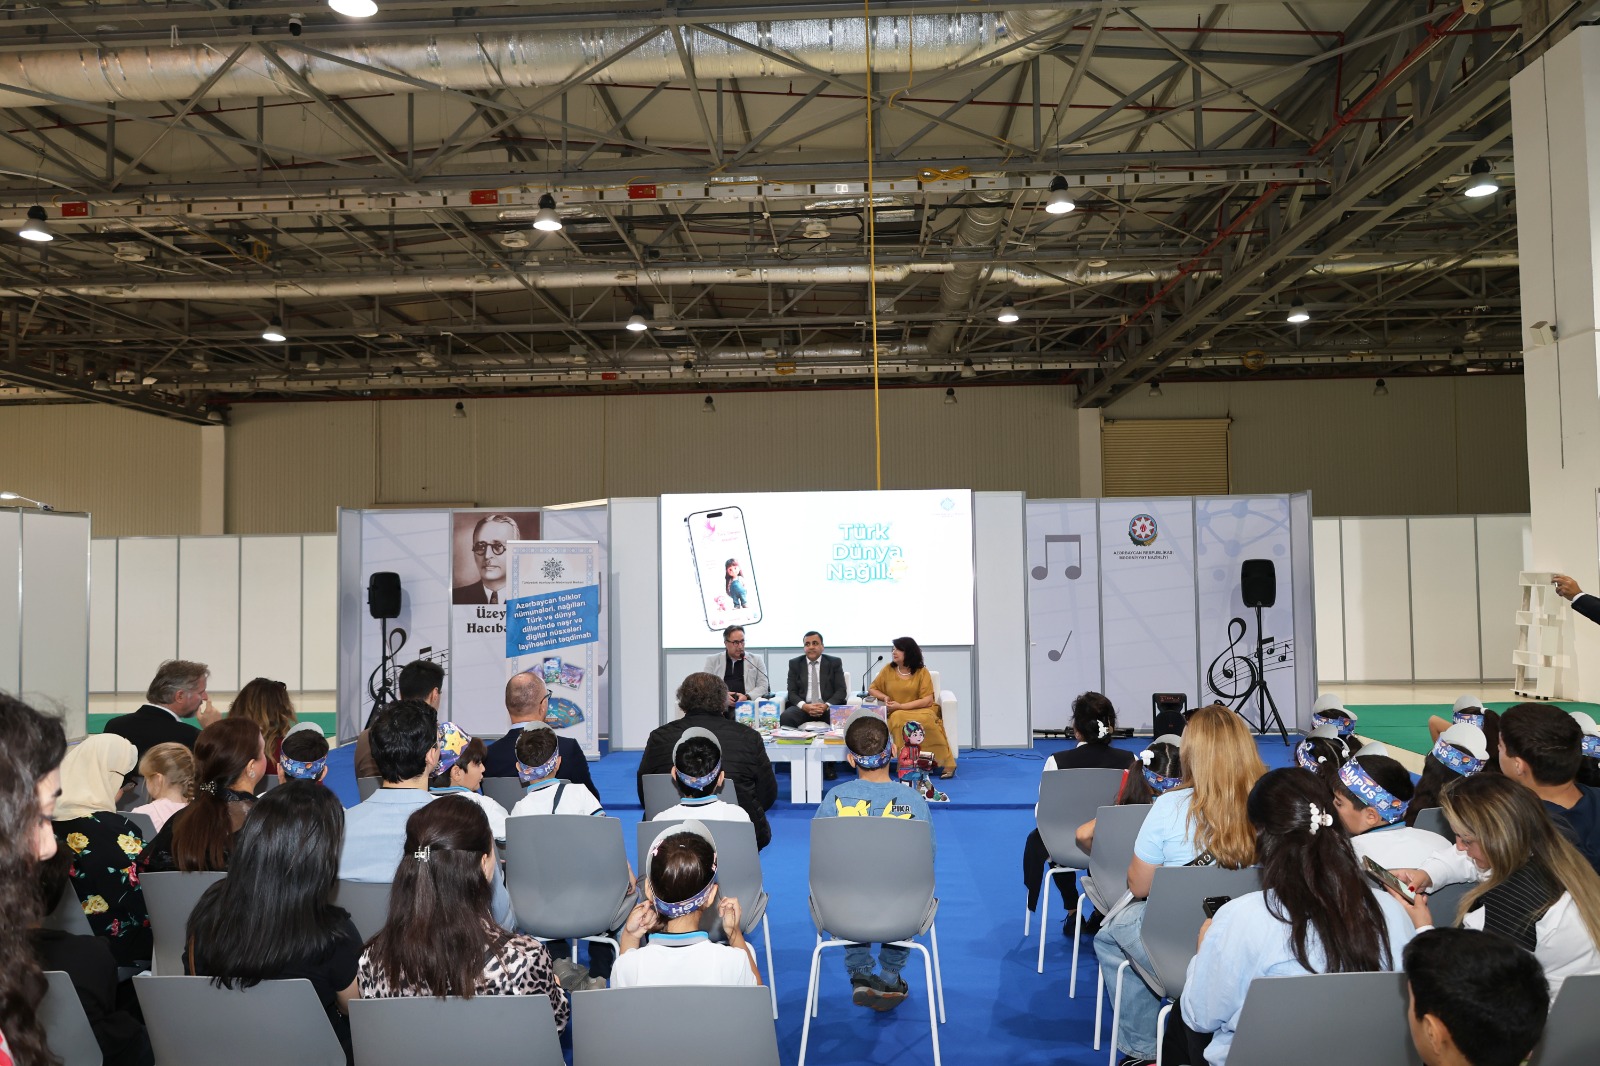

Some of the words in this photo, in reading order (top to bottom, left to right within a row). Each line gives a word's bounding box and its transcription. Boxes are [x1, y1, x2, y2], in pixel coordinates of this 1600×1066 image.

[839, 522, 890, 541] Türk
[832, 543, 903, 563] Dünya
[515, 597, 557, 610] Azərbaycan
[558, 593, 581, 602] folklor
[557, 601, 586, 613] nağılları
[476, 606, 506, 620] Üzey
[526, 616, 543, 624] Türk
[554, 611, 577, 620] dünya
[522, 621, 555, 633] dillərində
[556, 619, 573, 628] nəşr
[525, 631, 548, 641] digital
[549, 626, 582, 637] nüsxələri
[518, 639, 557, 651] layihəsinin
[558, 632, 592, 644] təqdimatı
[1342, 761, 1377, 799] CAMPUS
[891, 805, 910, 813] PIKA
